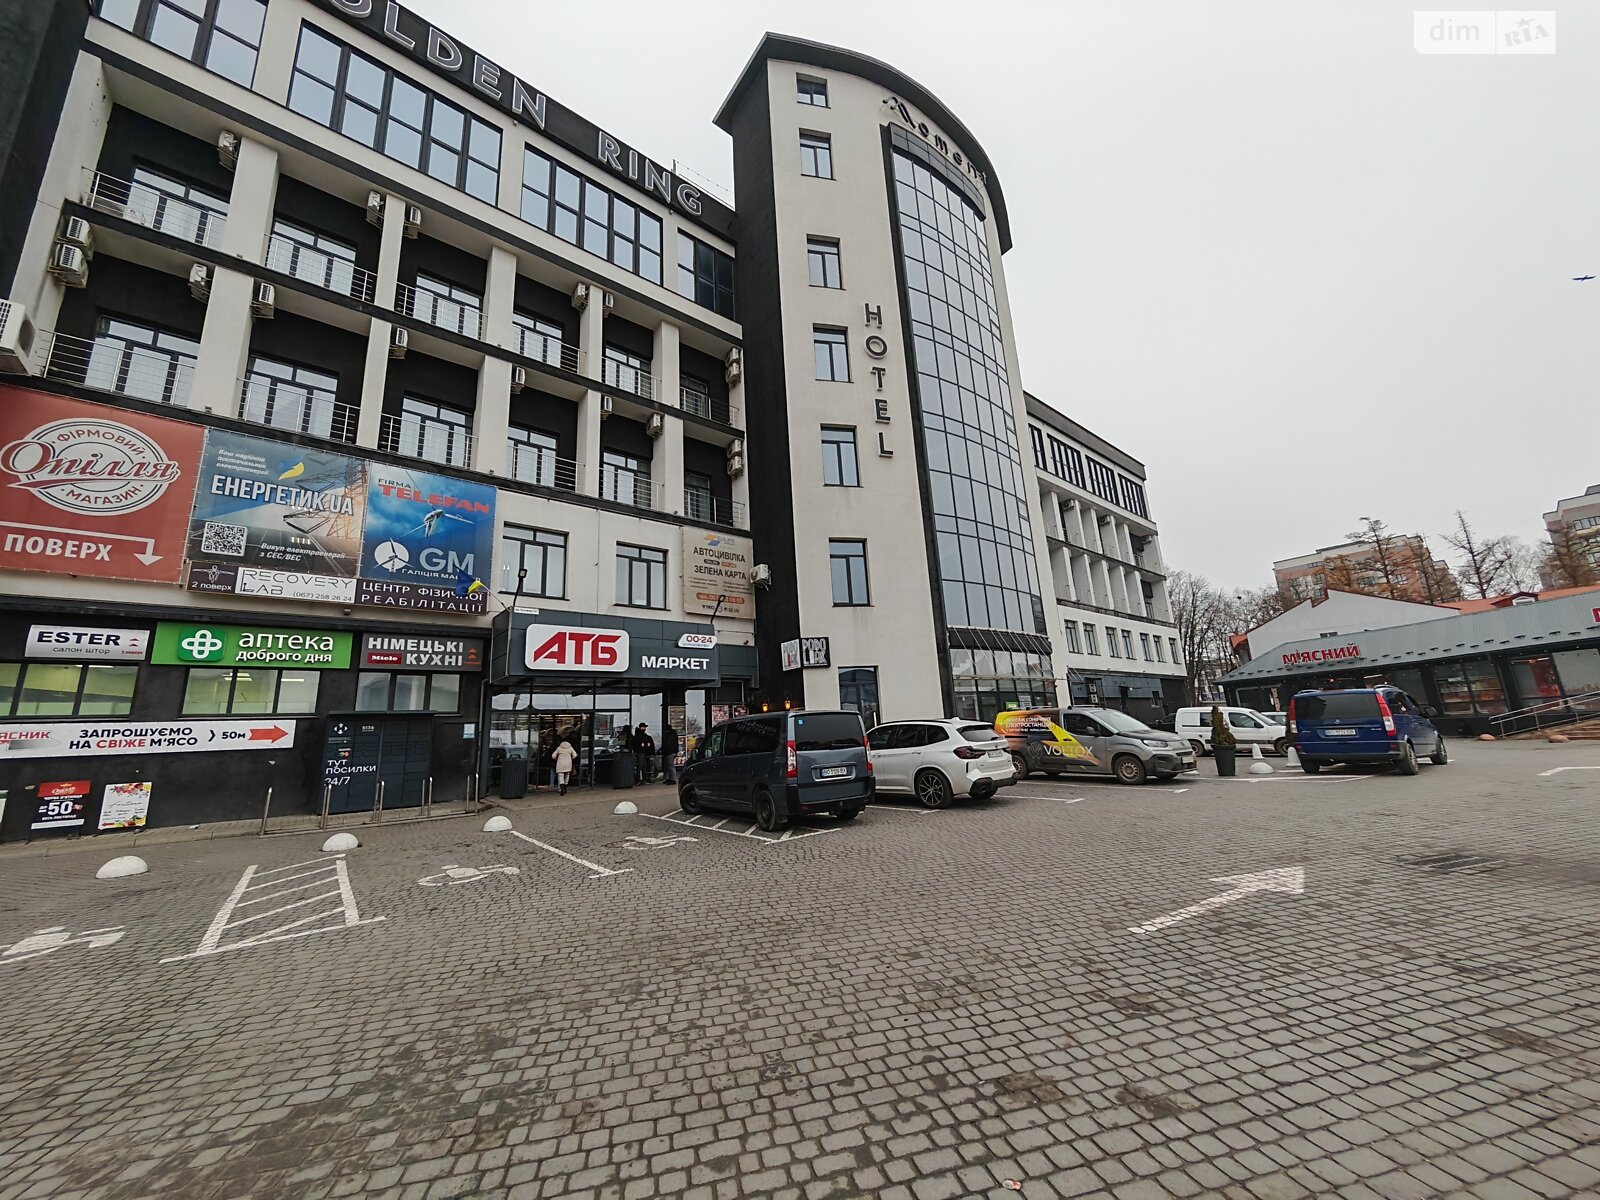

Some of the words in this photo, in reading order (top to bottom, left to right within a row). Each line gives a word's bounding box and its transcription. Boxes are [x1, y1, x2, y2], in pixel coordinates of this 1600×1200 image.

[598, 130, 703, 216] RING
[864, 302, 894, 458] HOTEL
[57, 429, 145, 456] ФІРМОВИЙ
[1, 441, 178, 479] Опілля
[378, 478, 411, 489] FIRMA
[66, 487, 142, 505] МАГАЗИН
[378, 484, 490, 514] TELEFAN
[4, 533, 113, 562] ПОВЕРХ
[693, 547, 746, 563] АВТОЦИВІЛКА
[419, 547, 475, 576] GM
[240, 568, 353, 589] RECOVERY
[402, 568, 439, 578] ГАЛІЦІЯ
[694, 565, 723, 576] ЗЕЛЕНА
[725, 570, 747, 580] КАРТА
[200, 583, 233, 591] поверх
[243, 583, 284, 596] LAB
[363, 582, 411, 594] ЦЕНТР
[418, 587, 483, 601] ФІЗИОЇ
[293, 591, 314, 599] (067)
[361, 594, 483, 613] РЕАБІЛІТАЦІЇ
[37, 631, 121, 646] ESTER
[238, 632, 334, 651] аптека
[367, 637, 464, 653] НІМЕЦЬКІ
[236, 649, 301, 662] доброго
[305, 653, 332, 662] дня
[533, 631, 622, 666] АТБ
[406, 653, 463, 666] КУХНІ
[641, 655, 710, 670] МАРКЕТ
[79, 727, 193, 739] ЗАПРОШУЄМО
[221, 731, 246, 739] 50м
[69, 739, 92, 749] НА
[96, 739, 145, 748] СВІЖЕ
[1043, 745, 1094, 757] VOLTOX
[325, 765, 377, 774] посилки
